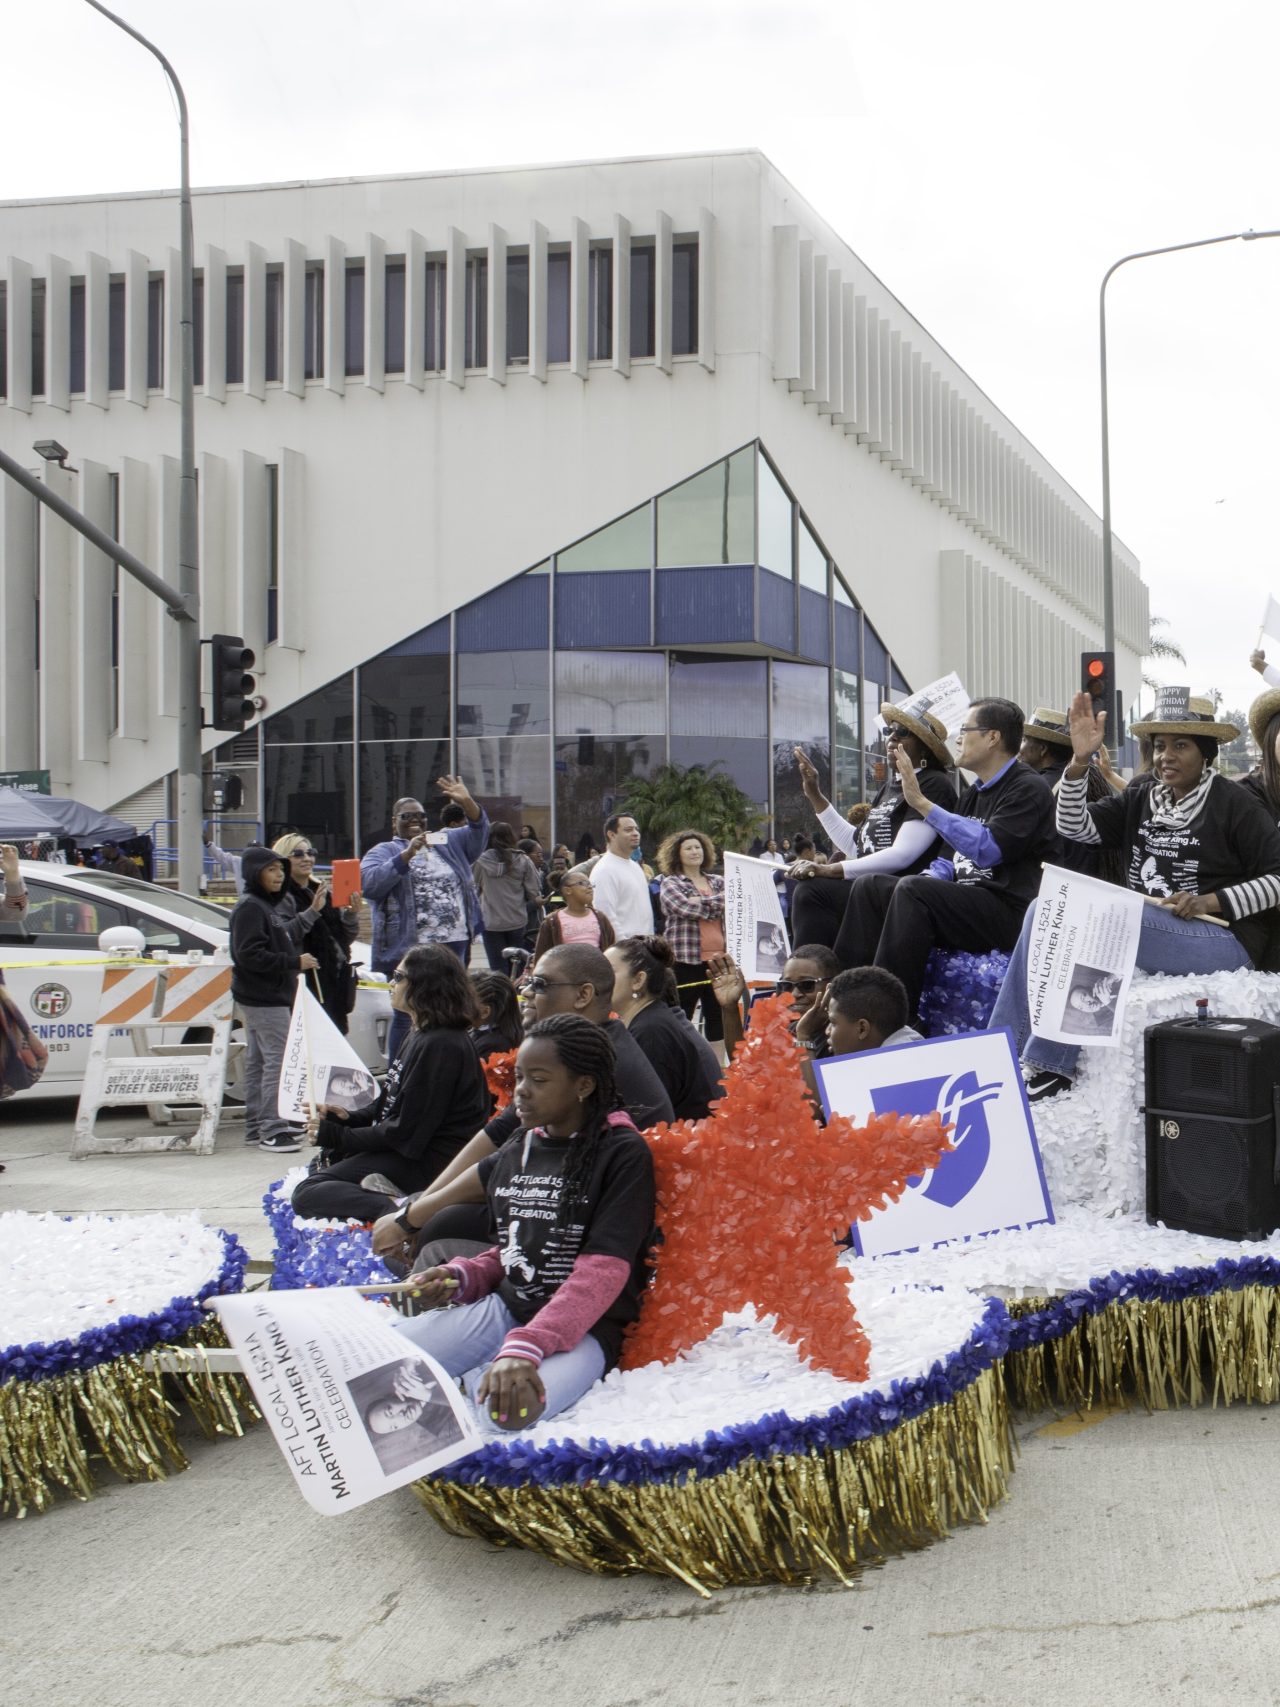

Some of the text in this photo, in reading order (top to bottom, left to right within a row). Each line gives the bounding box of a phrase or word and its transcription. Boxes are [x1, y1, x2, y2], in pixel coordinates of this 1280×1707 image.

[1164, 706, 1184, 715] KING
[1171, 836, 1189, 846] King
[728, 878, 736, 903] 1521A
[1031, 935, 1045, 974] LOCAL
[1038, 898, 1053, 932] 1521A
[1033, 981, 1048, 1027] MARTIN
[1042, 933, 1059, 979] LUTHER
[1051, 899, 1066, 929] KING
[1060, 882, 1070, 899] JR.
[1057, 926, 1078, 991] CELEBRATION
[105, 1081, 198, 1094] STREET SERVICES
[108, 1073, 199, 1084] DEPT. OF PUBLIC WORKS
[283, 1070, 295, 1093] AFT
[289, 1037, 303, 1070] LOCAL
[510, 1174, 529, 1185] AFT
[528, 1174, 553, 1185] Local
[265, 1321, 292, 1366] KING
[244, 1331, 317, 1477] AFT LOCAL 1521A
[284, 1365, 322, 1433] LUTHER
[305, 1339, 352, 1430] CELEBRATION
[314, 1429, 350, 1500] MARTIN
